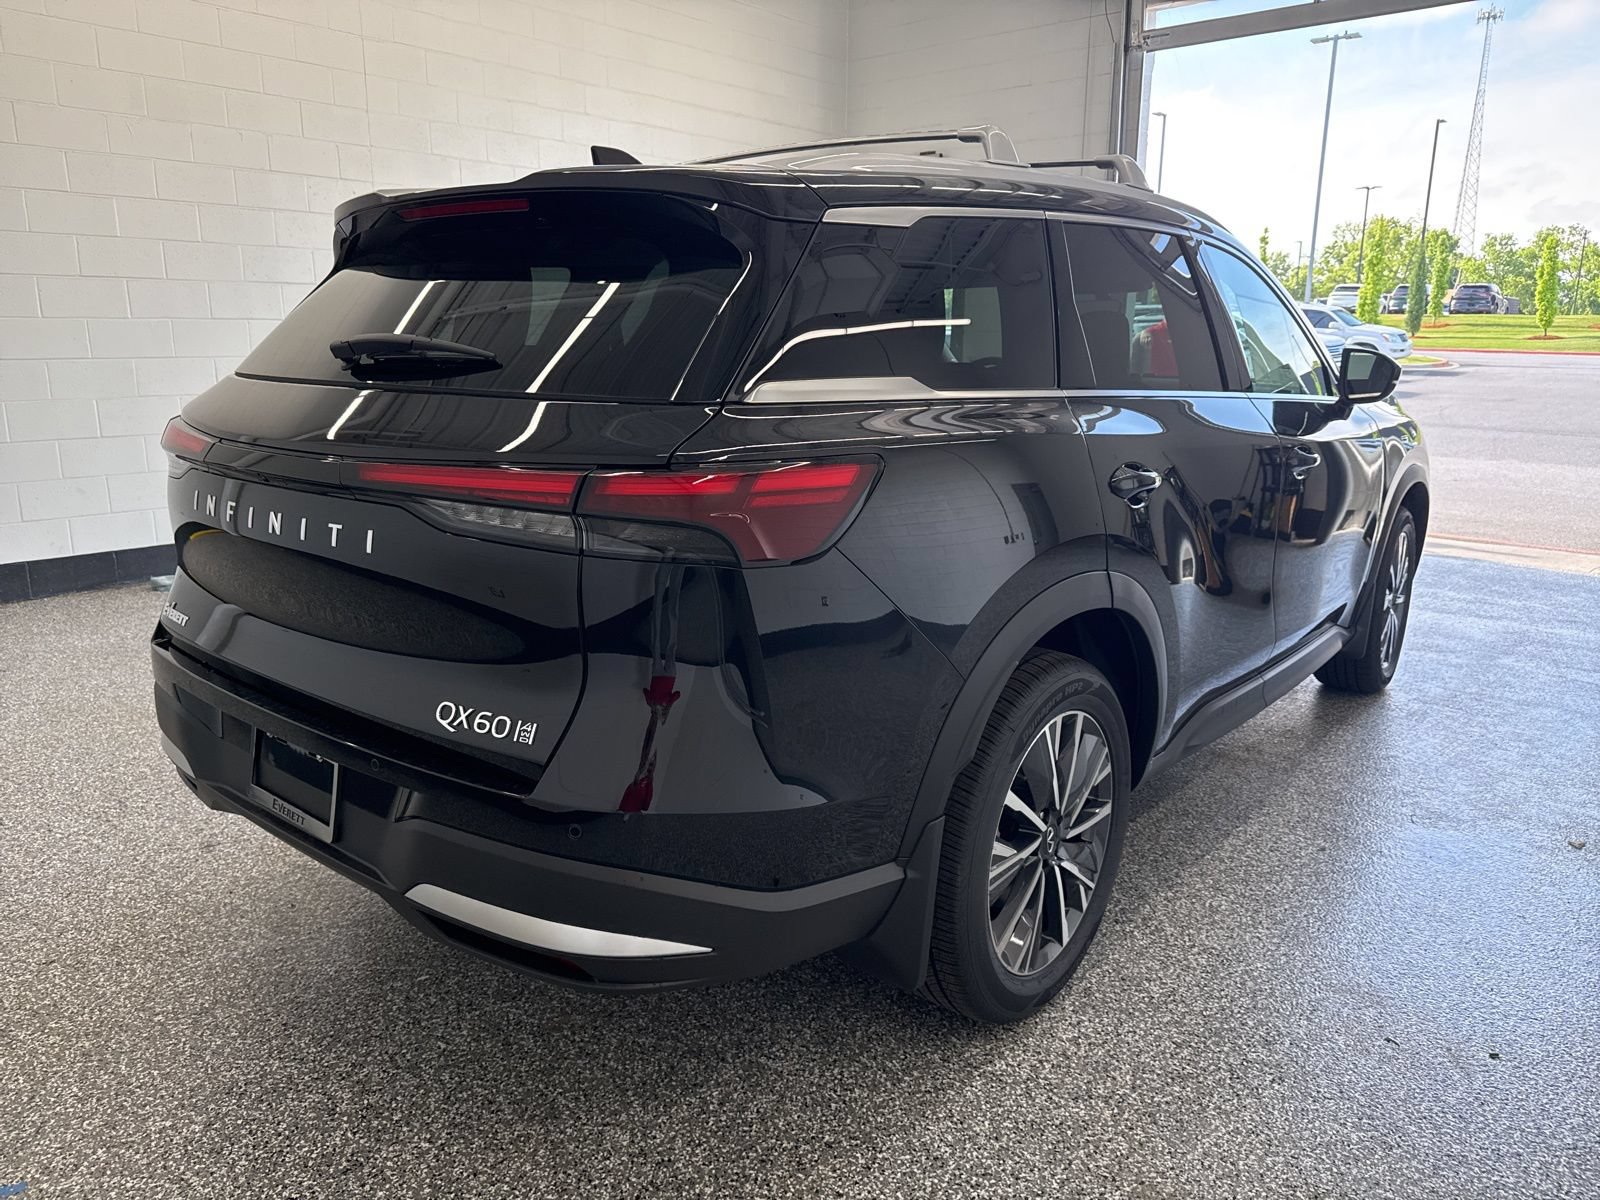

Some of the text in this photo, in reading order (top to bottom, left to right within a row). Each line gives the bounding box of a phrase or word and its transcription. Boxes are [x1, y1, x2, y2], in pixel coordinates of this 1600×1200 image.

[193, 489, 374, 554] INFINITI
[1064, 681, 1084, 696] HP2
[435, 701, 512, 739] QX60
[519, 722, 532, 744] AWD
